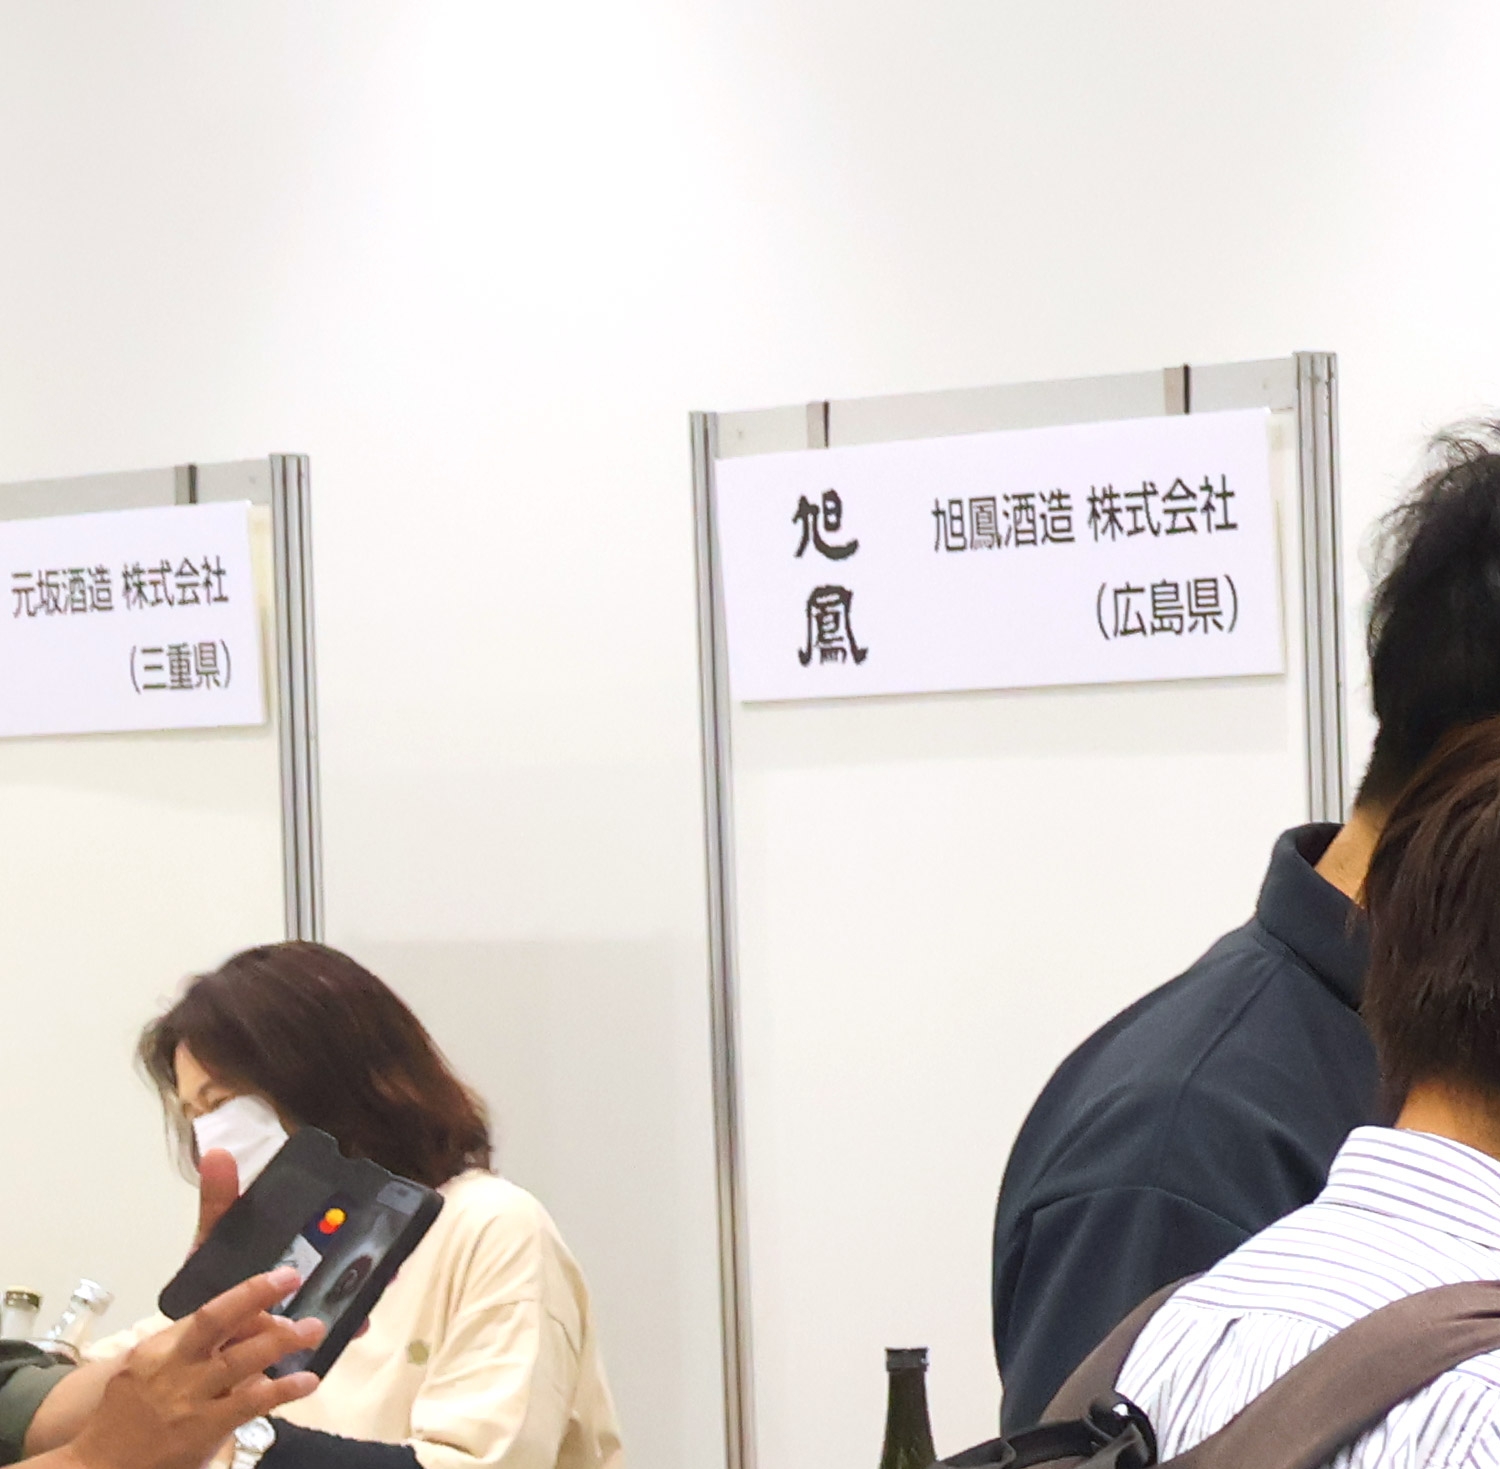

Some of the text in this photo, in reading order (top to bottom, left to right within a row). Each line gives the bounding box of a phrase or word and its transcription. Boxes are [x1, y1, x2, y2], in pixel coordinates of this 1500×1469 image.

[932, 474, 1238, 553] 旭鳳酒造 株式会社
[11, 556, 229, 618] 元坂酒造 株式会社
[1097, 575, 1238, 640] （広島県）
[130, 639, 231, 694] （三重県）
